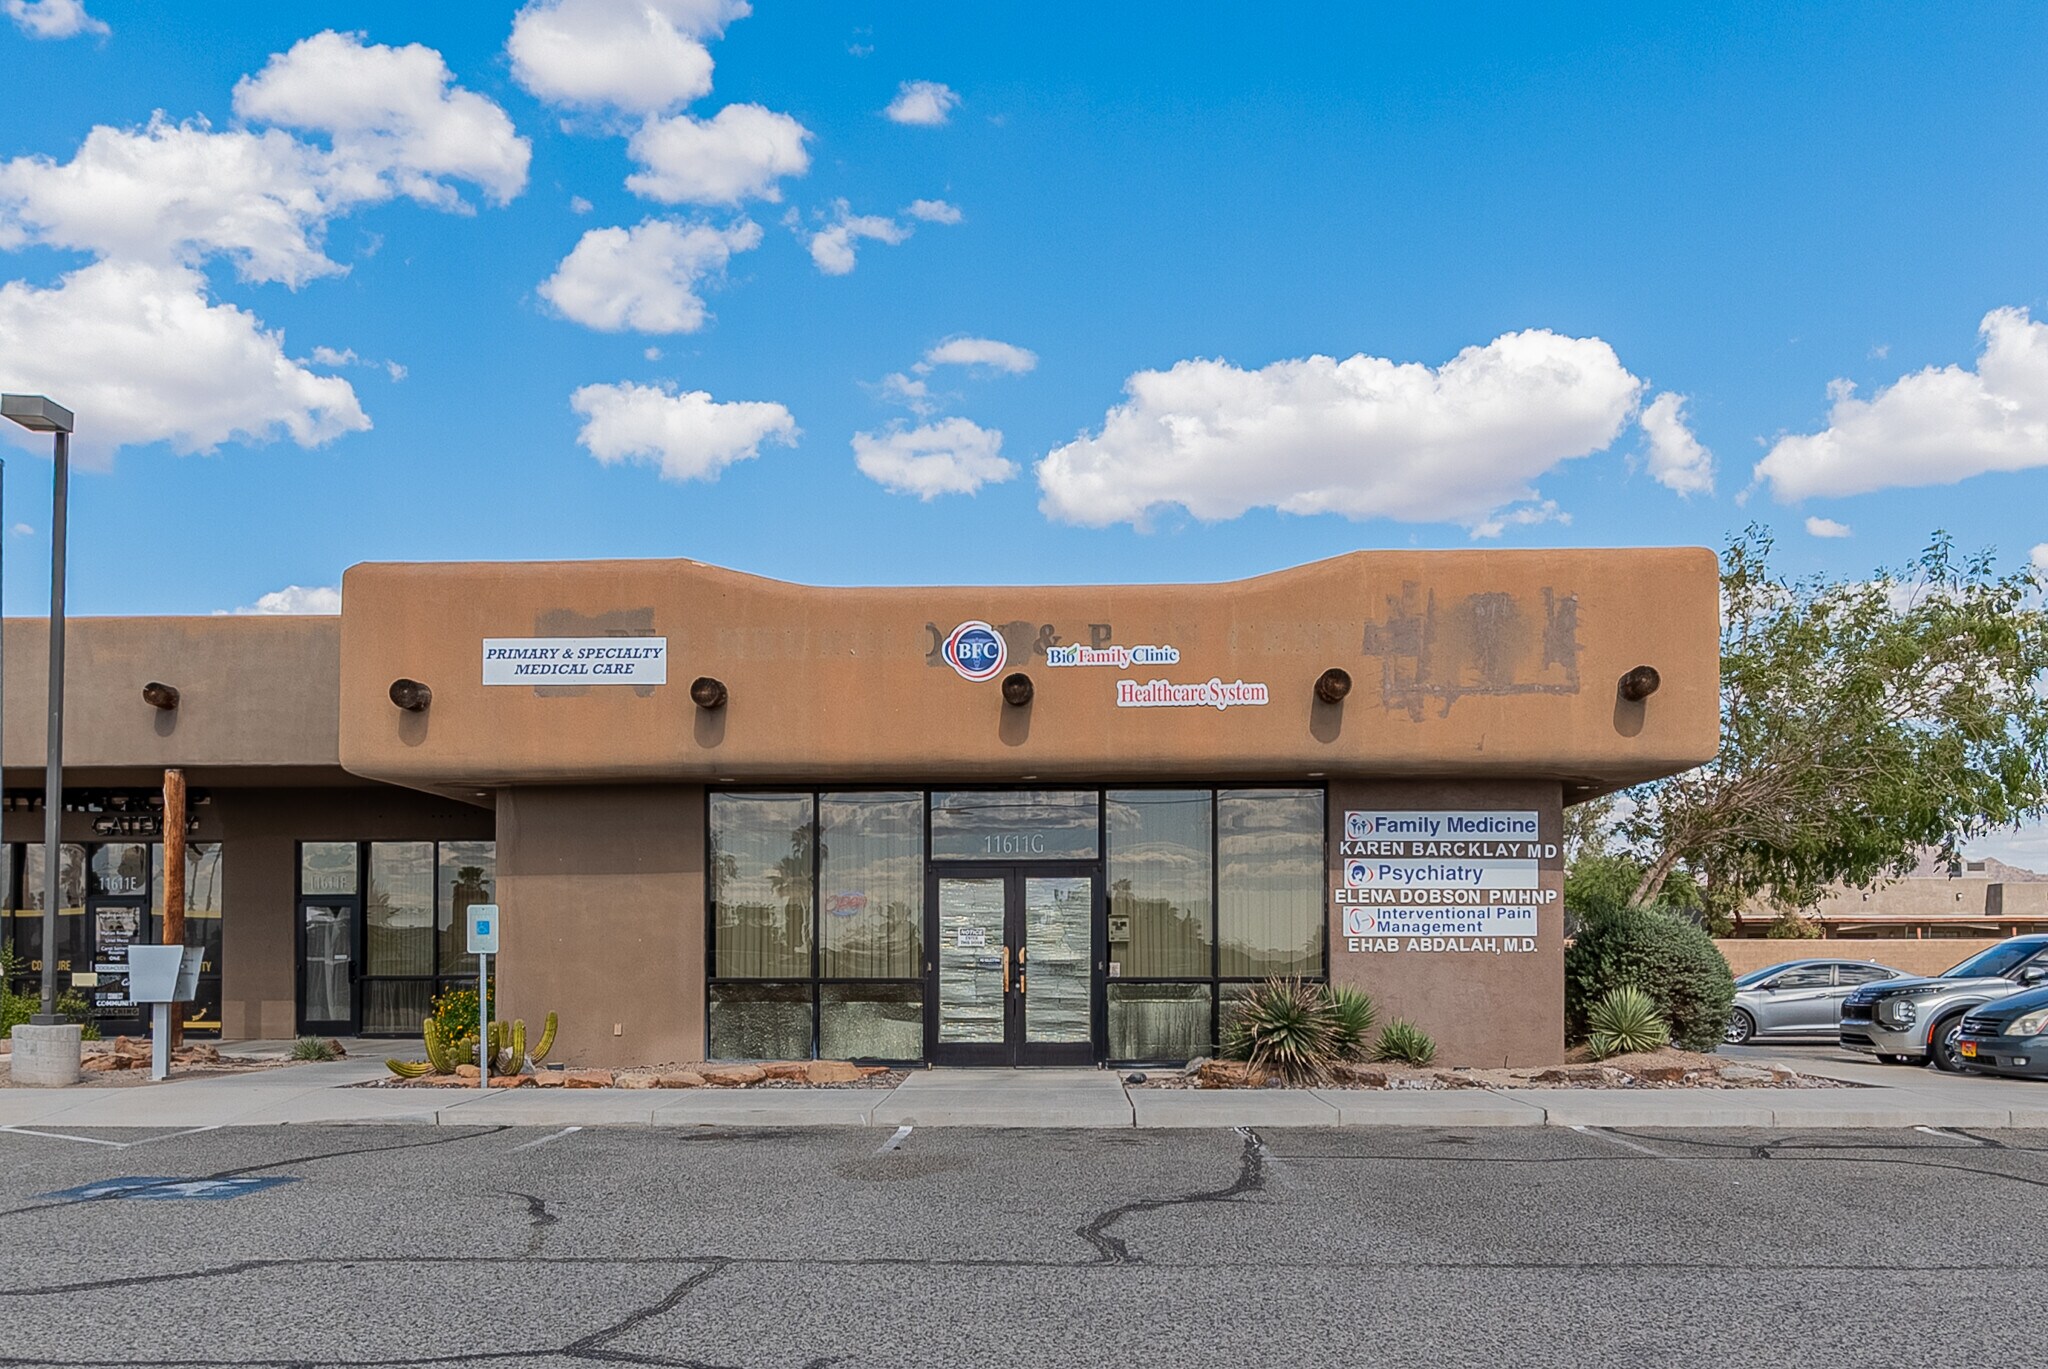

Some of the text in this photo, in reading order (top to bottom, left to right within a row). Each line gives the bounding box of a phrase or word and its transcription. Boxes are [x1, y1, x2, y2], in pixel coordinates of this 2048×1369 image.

[486, 648, 663, 659] PRIMARY & SPECIALTY
[958, 643, 998, 659] BFC
[1050, 648, 1177, 666] Bio Family Clinic
[514, 664, 635, 675] MEDICAL CARE
[1121, 682, 1265, 705] Healthcare System
[1375, 817, 1536, 836] Family Medicine
[985, 834, 1044, 853] 11611G
[1340, 841, 1557, 858] KAREN BARCKLAY MD
[1378, 864, 1483, 884] Psychiatry
[99, 876, 137, 890] 11611E
[1335, 889, 1557, 904] ELENA DOBSON PMHNP
[1377, 907, 1531, 919] Interventional Pain
[1377, 921, 1483, 935] Management
[1348, 938, 1538, 955] EHAB ABDALAH, M.D.
